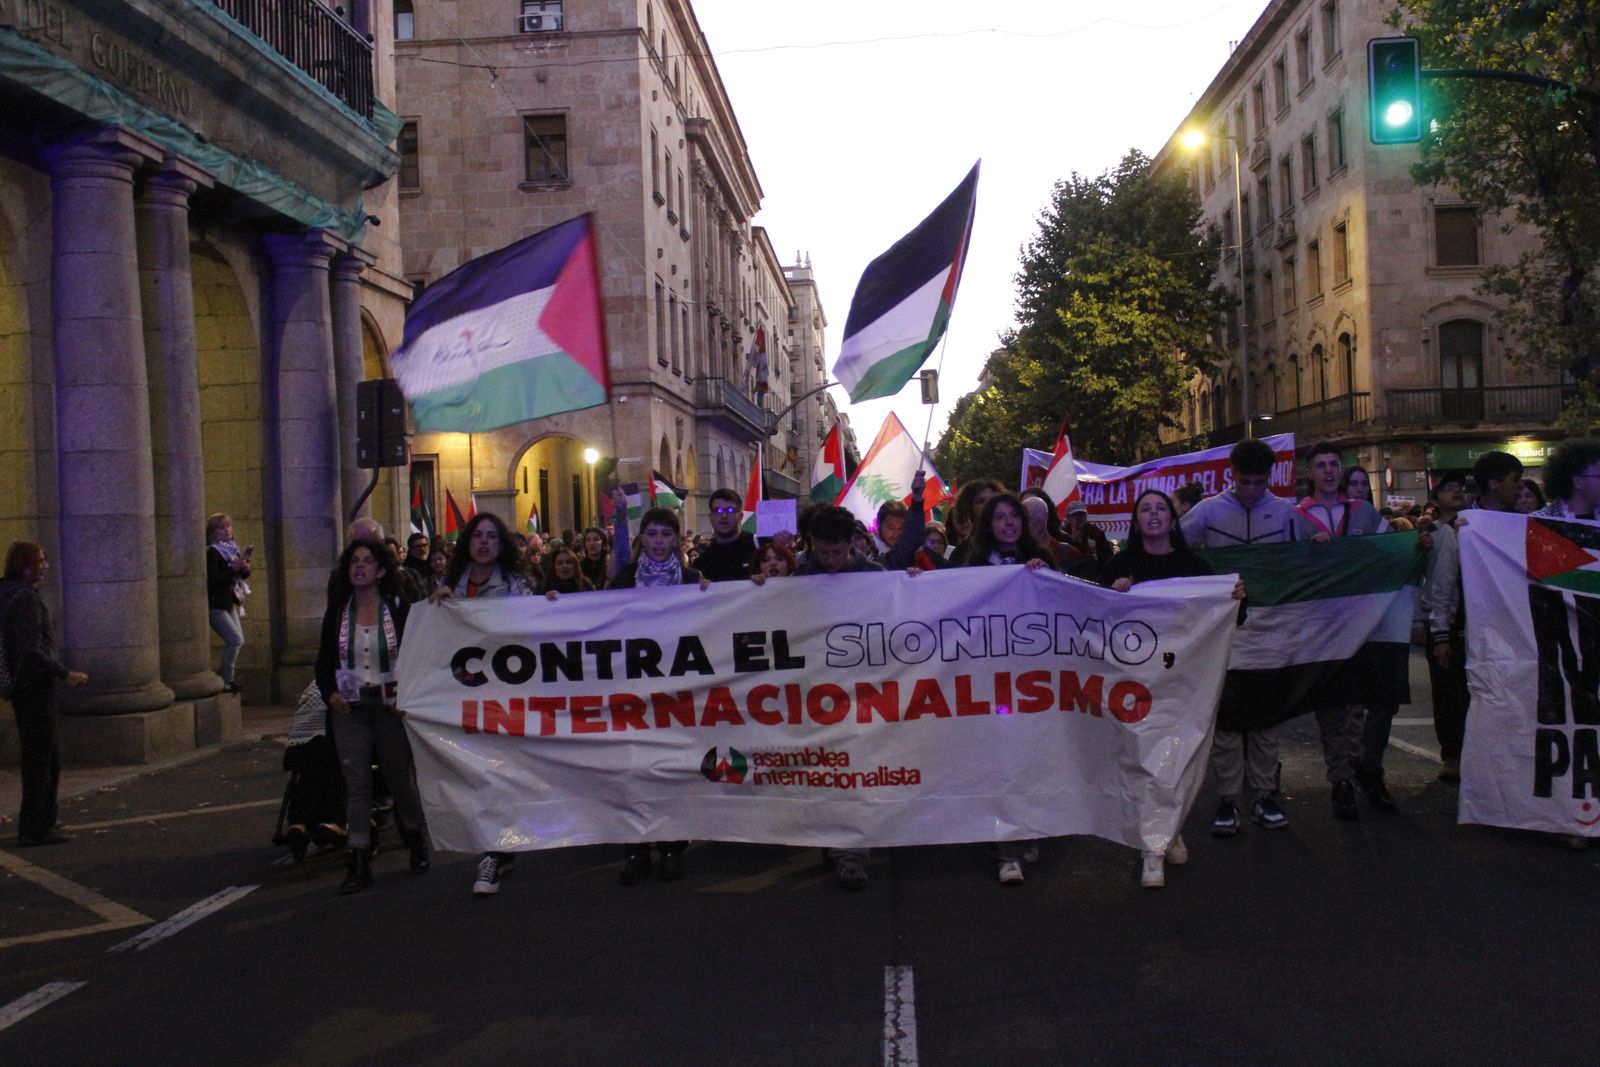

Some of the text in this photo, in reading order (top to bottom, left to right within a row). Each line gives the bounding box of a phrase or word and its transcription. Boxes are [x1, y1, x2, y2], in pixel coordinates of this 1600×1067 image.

[92, 32, 192, 117] GOBIERNO
[1517, 447, 1544, 457] Salud
[1109, 481, 1128, 504] LA
[1133, 473, 1187, 505] TUMBA
[1193, 471, 1217, 495] DEL
[383, 603, 398, 660] ALESTINE
[450, 612, 1176, 687] CONTRA EL SIONISMO,
[461, 670, 1153, 737] INTERNACIONALISMO
[753, 746, 849, 767] asamblea
[753, 766, 922, 790] internacionalista
